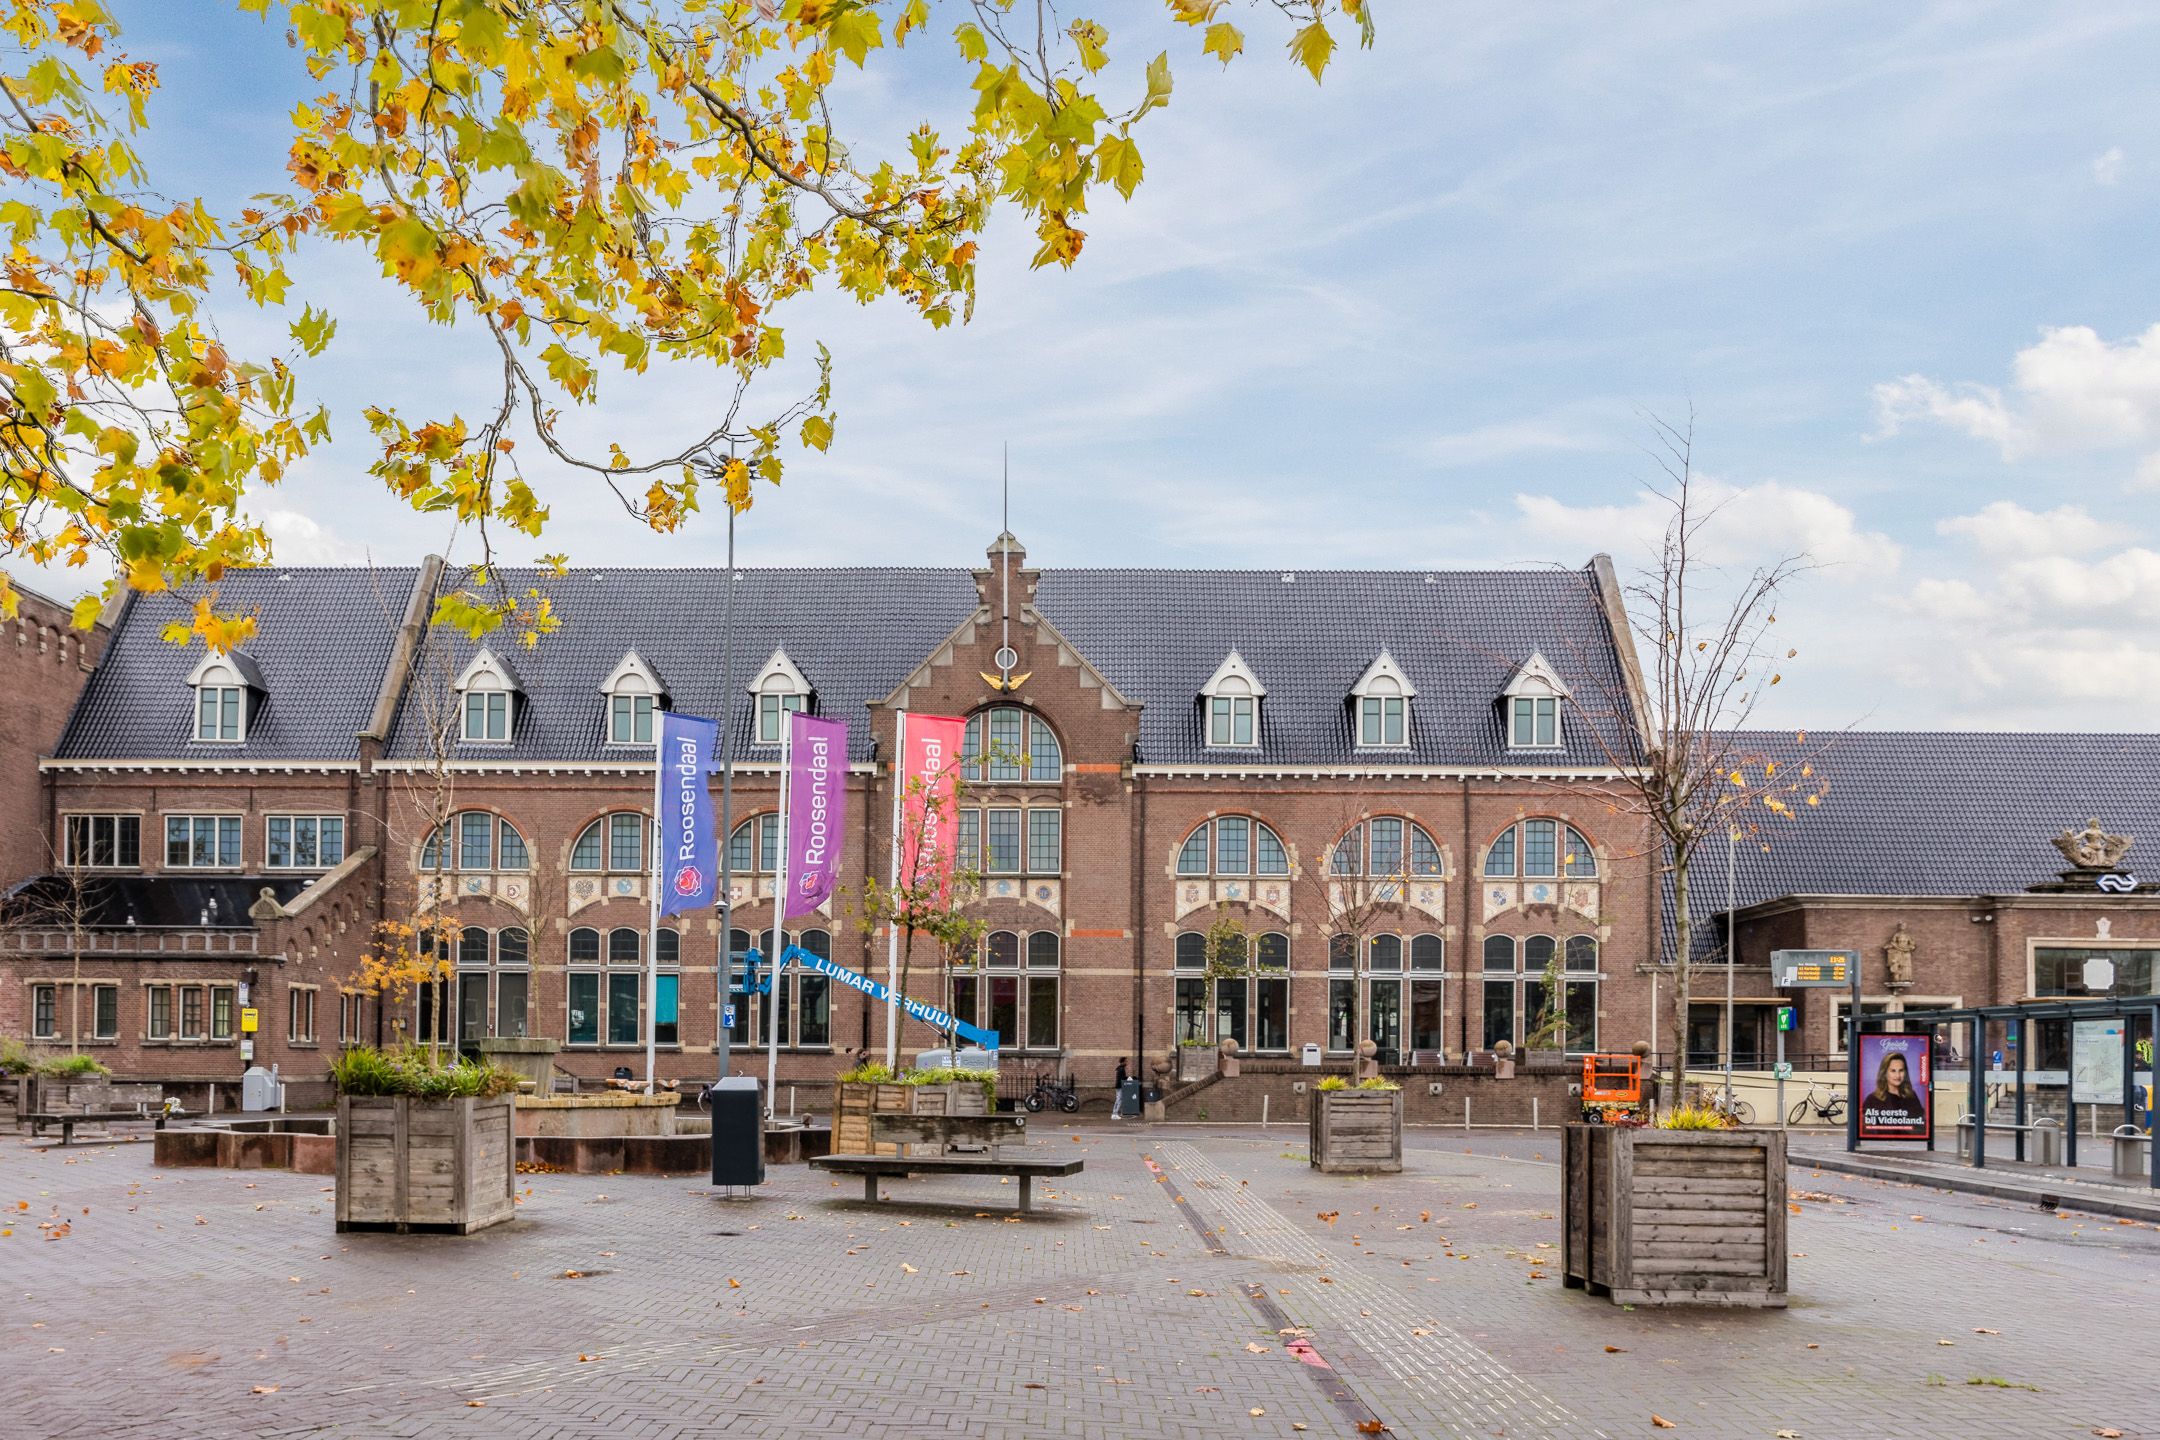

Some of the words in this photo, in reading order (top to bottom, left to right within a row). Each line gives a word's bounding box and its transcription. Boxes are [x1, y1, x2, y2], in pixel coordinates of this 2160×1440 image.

[676, 736, 697, 861] Roosendaal
[805, 736, 829, 865] Roosendaal
[815, 958, 875, 994] LUMAR
[1865, 1108, 1879, 1116] Als
[1880, 1108, 1908, 1116] eerste
[1865, 1116, 1876, 1125] bij
[1878, 1116, 1925, 1125] Videoland.
